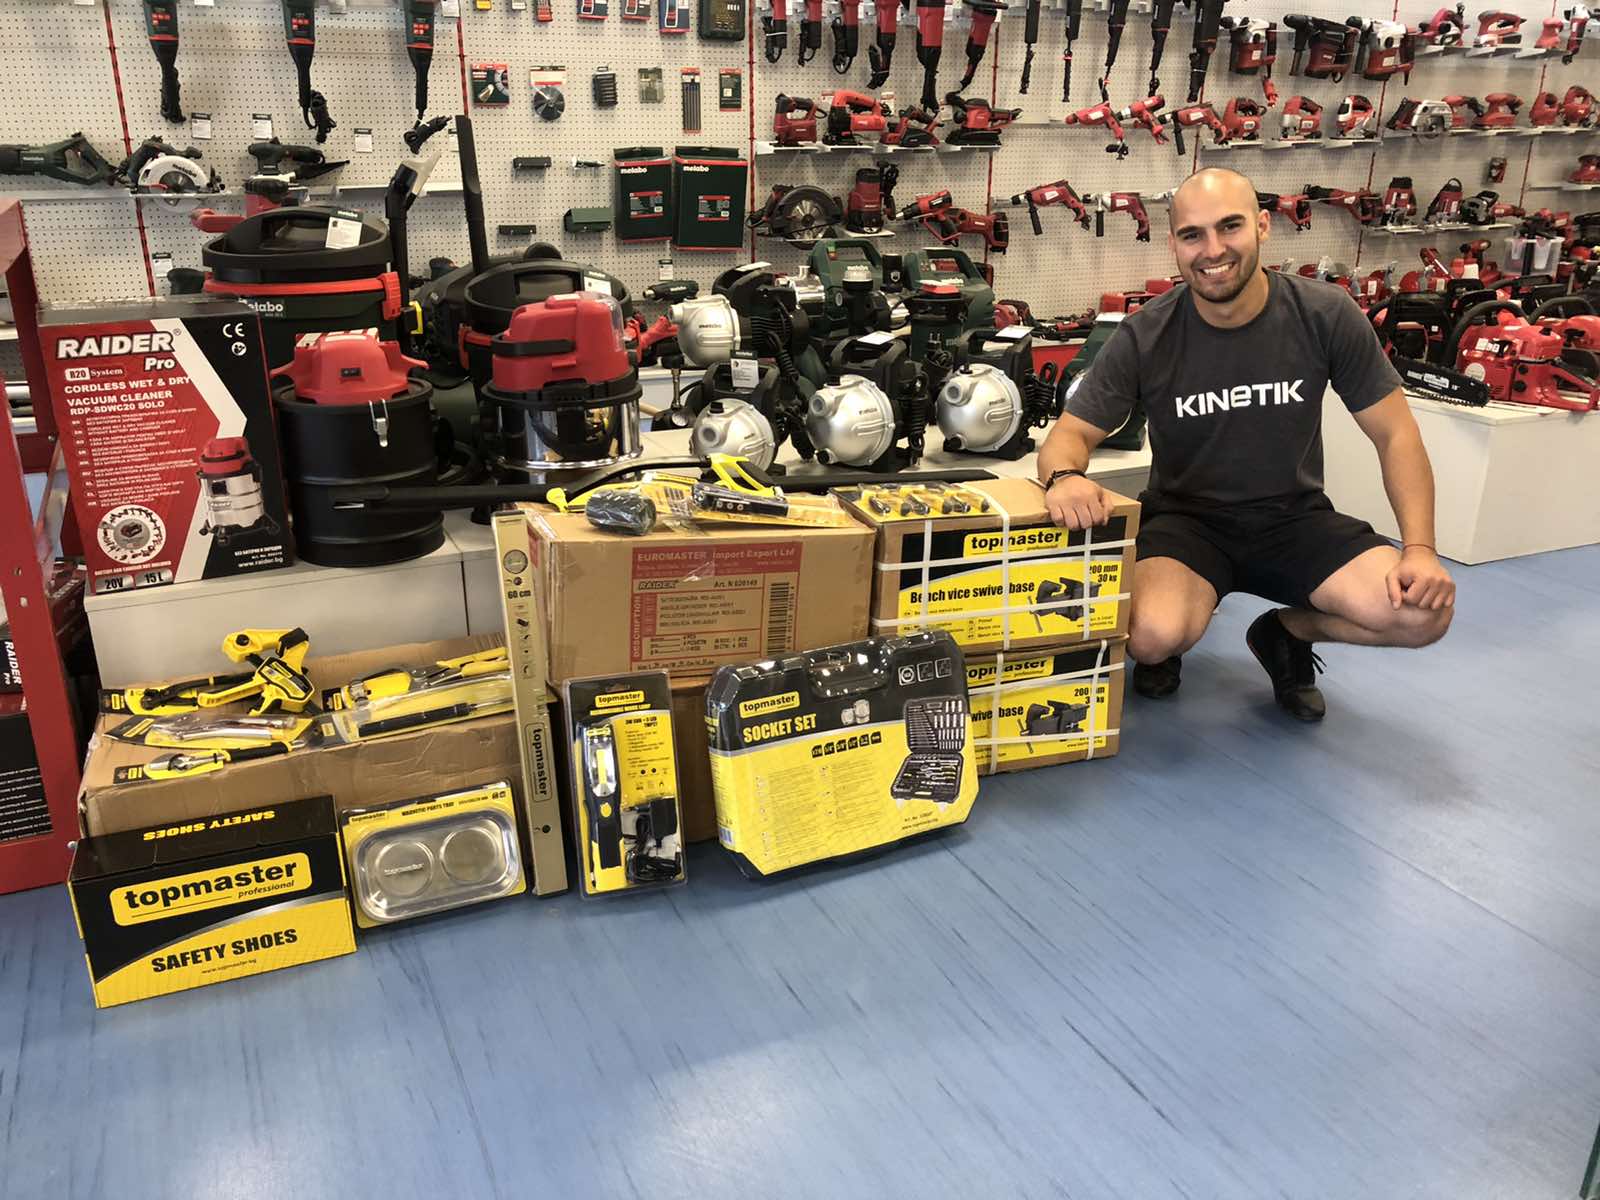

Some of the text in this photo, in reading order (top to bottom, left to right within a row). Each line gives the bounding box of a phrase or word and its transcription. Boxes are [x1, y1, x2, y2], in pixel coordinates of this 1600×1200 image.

[620, 166, 648, 174] metabo
[57, 333, 174, 359] RAIDER
[90, 367, 123, 377] System
[144, 357, 176, 371] Pro
[64, 376, 191, 394] CORDLESS WET & DRY
[67, 390, 173, 407] VACUUM CLEANER
[138, 400, 165, 411] SOLO
[971, 531, 1062, 551] topmaster
[637, 548, 794, 561] EUROMASTER Import Export Ltd
[1103, 564, 1118, 573] mm
[105, 577, 123, 589] 20V
[145, 572, 157, 584] 15
[638, 580, 677, 591] RAIDER
[1098, 573, 1108, 583] 30
[507, 590, 531, 599] 60 cm
[947, 587, 970, 600] vice
[972, 584, 1004, 598] swive
[1009, 582, 1035, 594] base
[4, 640, 23, 685] RAIDER
[967, 658, 1048, 679] opmaster
[598, 692, 641, 703] topmaster
[1074, 687, 1089, 697] 200
[744, 694, 796, 712] topmaster
[971, 705, 1024, 722] wive base
[742, 713, 817, 744] SOCKET SET
[532, 727, 548, 796] topmaster
[427, 804, 442, 812] PARTS
[143, 810, 276, 841] SAFETY SHOES
[124, 860, 297, 910] topmaster
[237, 880, 295, 900] professional
[151, 928, 298, 973] SAFETY SHOES
